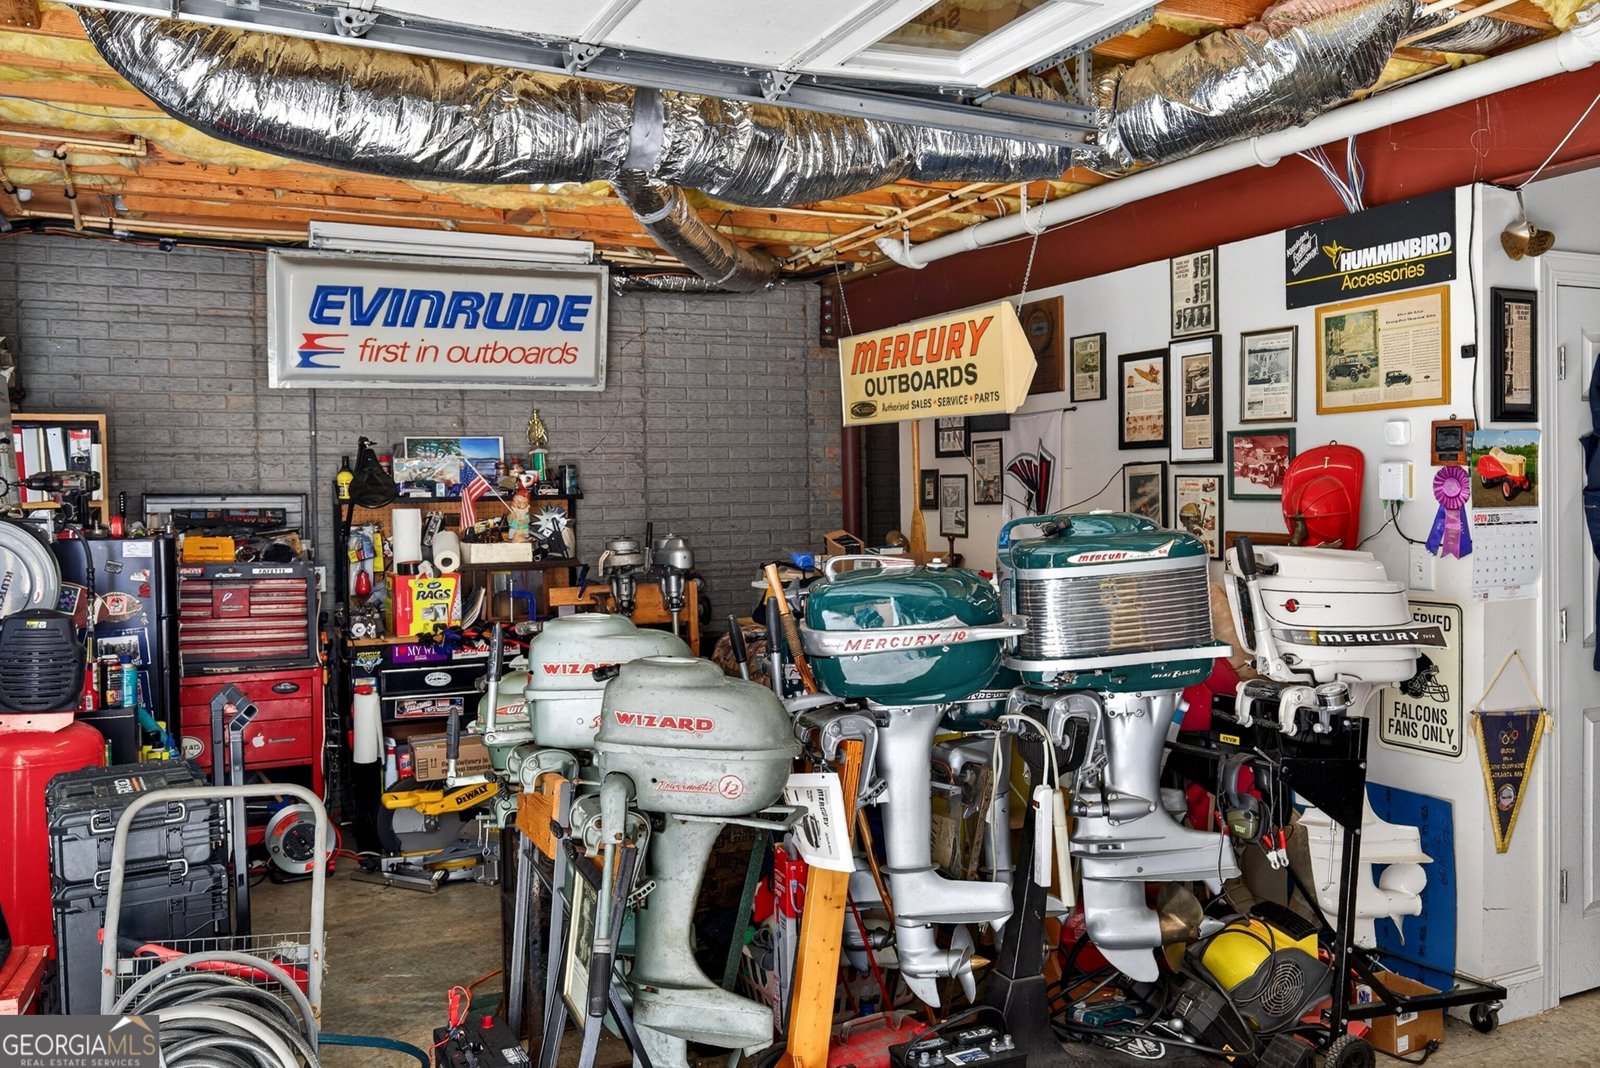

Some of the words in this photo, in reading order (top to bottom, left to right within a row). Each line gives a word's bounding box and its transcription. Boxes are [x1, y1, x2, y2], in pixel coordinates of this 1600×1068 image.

[1340, 231, 1452, 272] HUMMINBIRD
[1341, 262, 1425, 291] Accessories
[308, 284, 593, 332] EVINRUDE
[358, 338, 408, 364] first
[418, 338, 439, 364] in
[446, 340, 579, 365] outboards
[851, 315, 995, 376] MERCURY
[864, 363, 978, 398] OUTBOARDS
[911, 398, 933, 410] SALES
[937, 394, 969, 408] SERVICE
[974, 391, 1000, 404] PARTS
[1078, 552, 1127, 562] MERCURY
[416, 589, 451, 600] RAGS
[844, 633, 940, 652] MERCURY
[952, 631, 967, 642] 10
[1318, 632, 1420, 644] MERCURY
[614, 711, 714, 732] WIZARD
[1394, 701, 1448, 726] FALCONS
[1388, 718, 1418, 739] FANS
[1422, 724, 1454, 745] ONLY
[456, 785, 488, 805] DEWALT
[722, 781, 739, 796] 12
